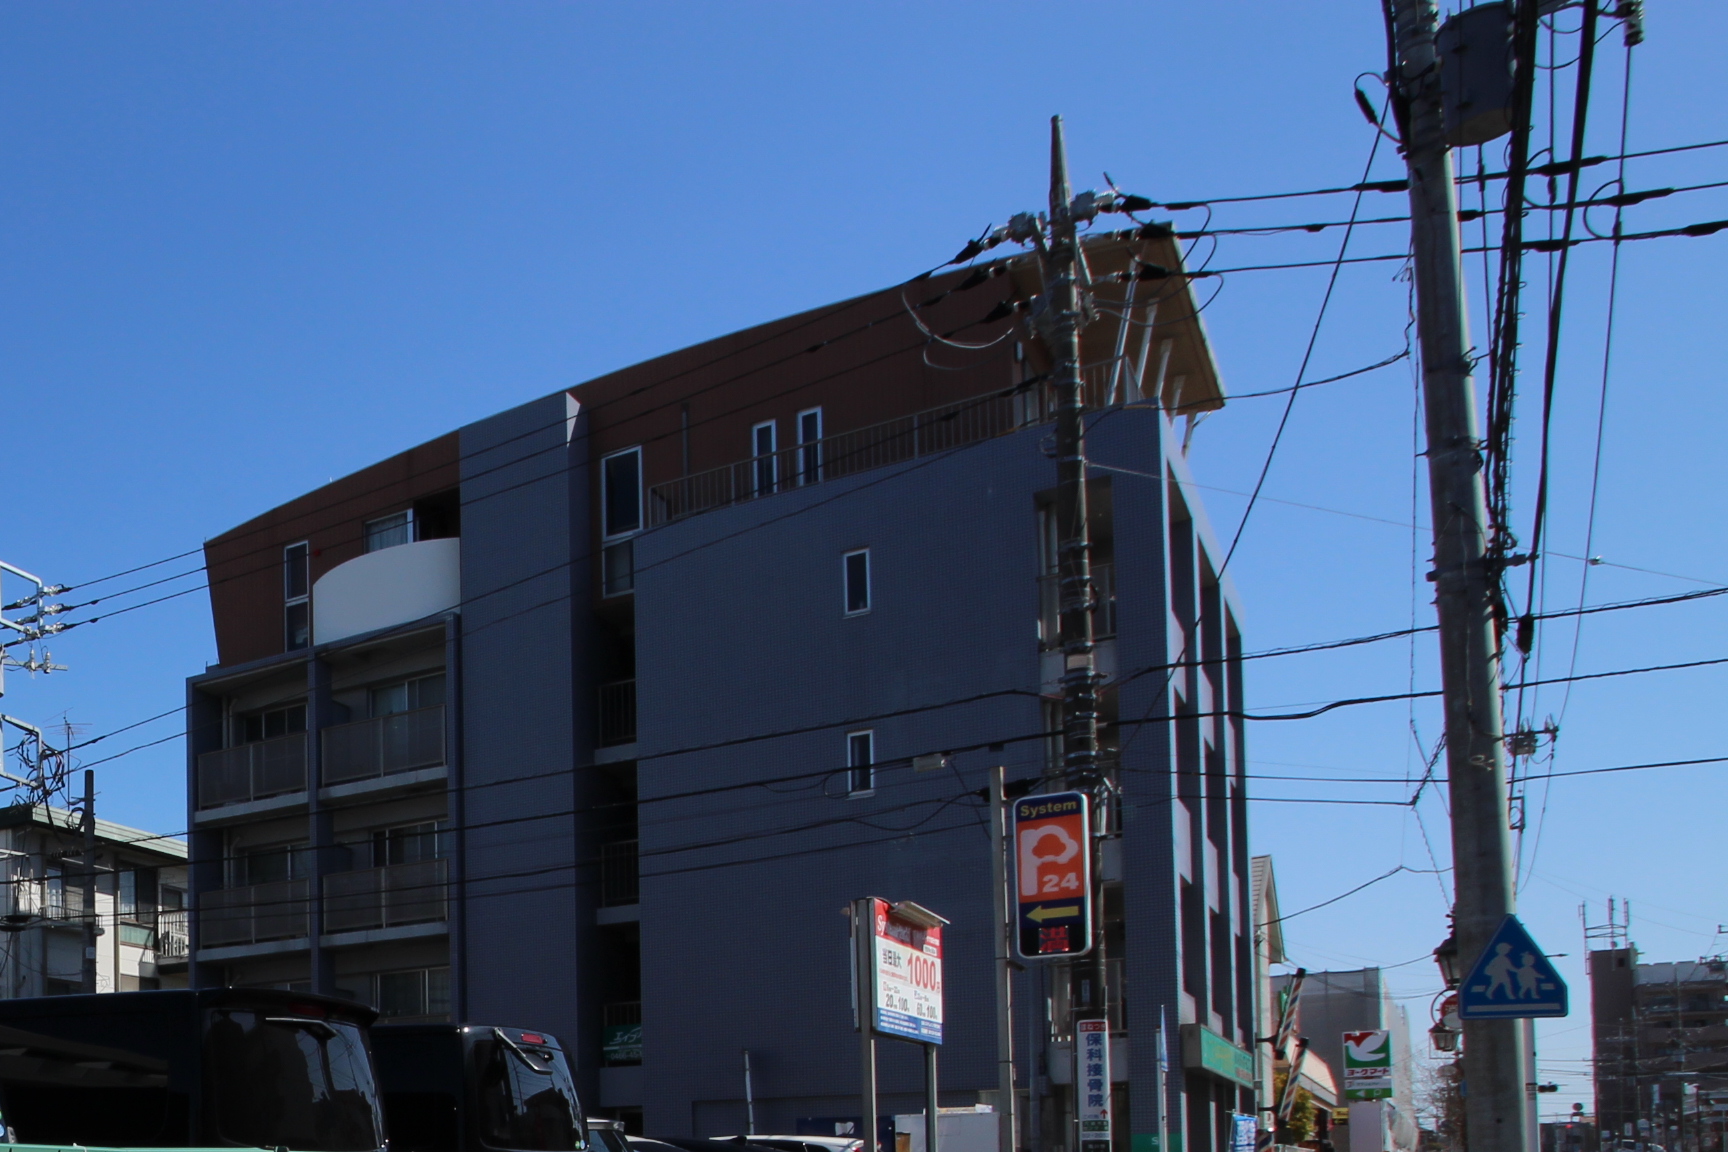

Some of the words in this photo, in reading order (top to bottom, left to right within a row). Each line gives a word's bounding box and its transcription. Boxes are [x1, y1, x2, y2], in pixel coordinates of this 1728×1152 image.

[1021, 799, 1078, 818] System
[1042, 872, 1080, 893] 24
[1347, 1067, 1389, 1077] ヨークマート
